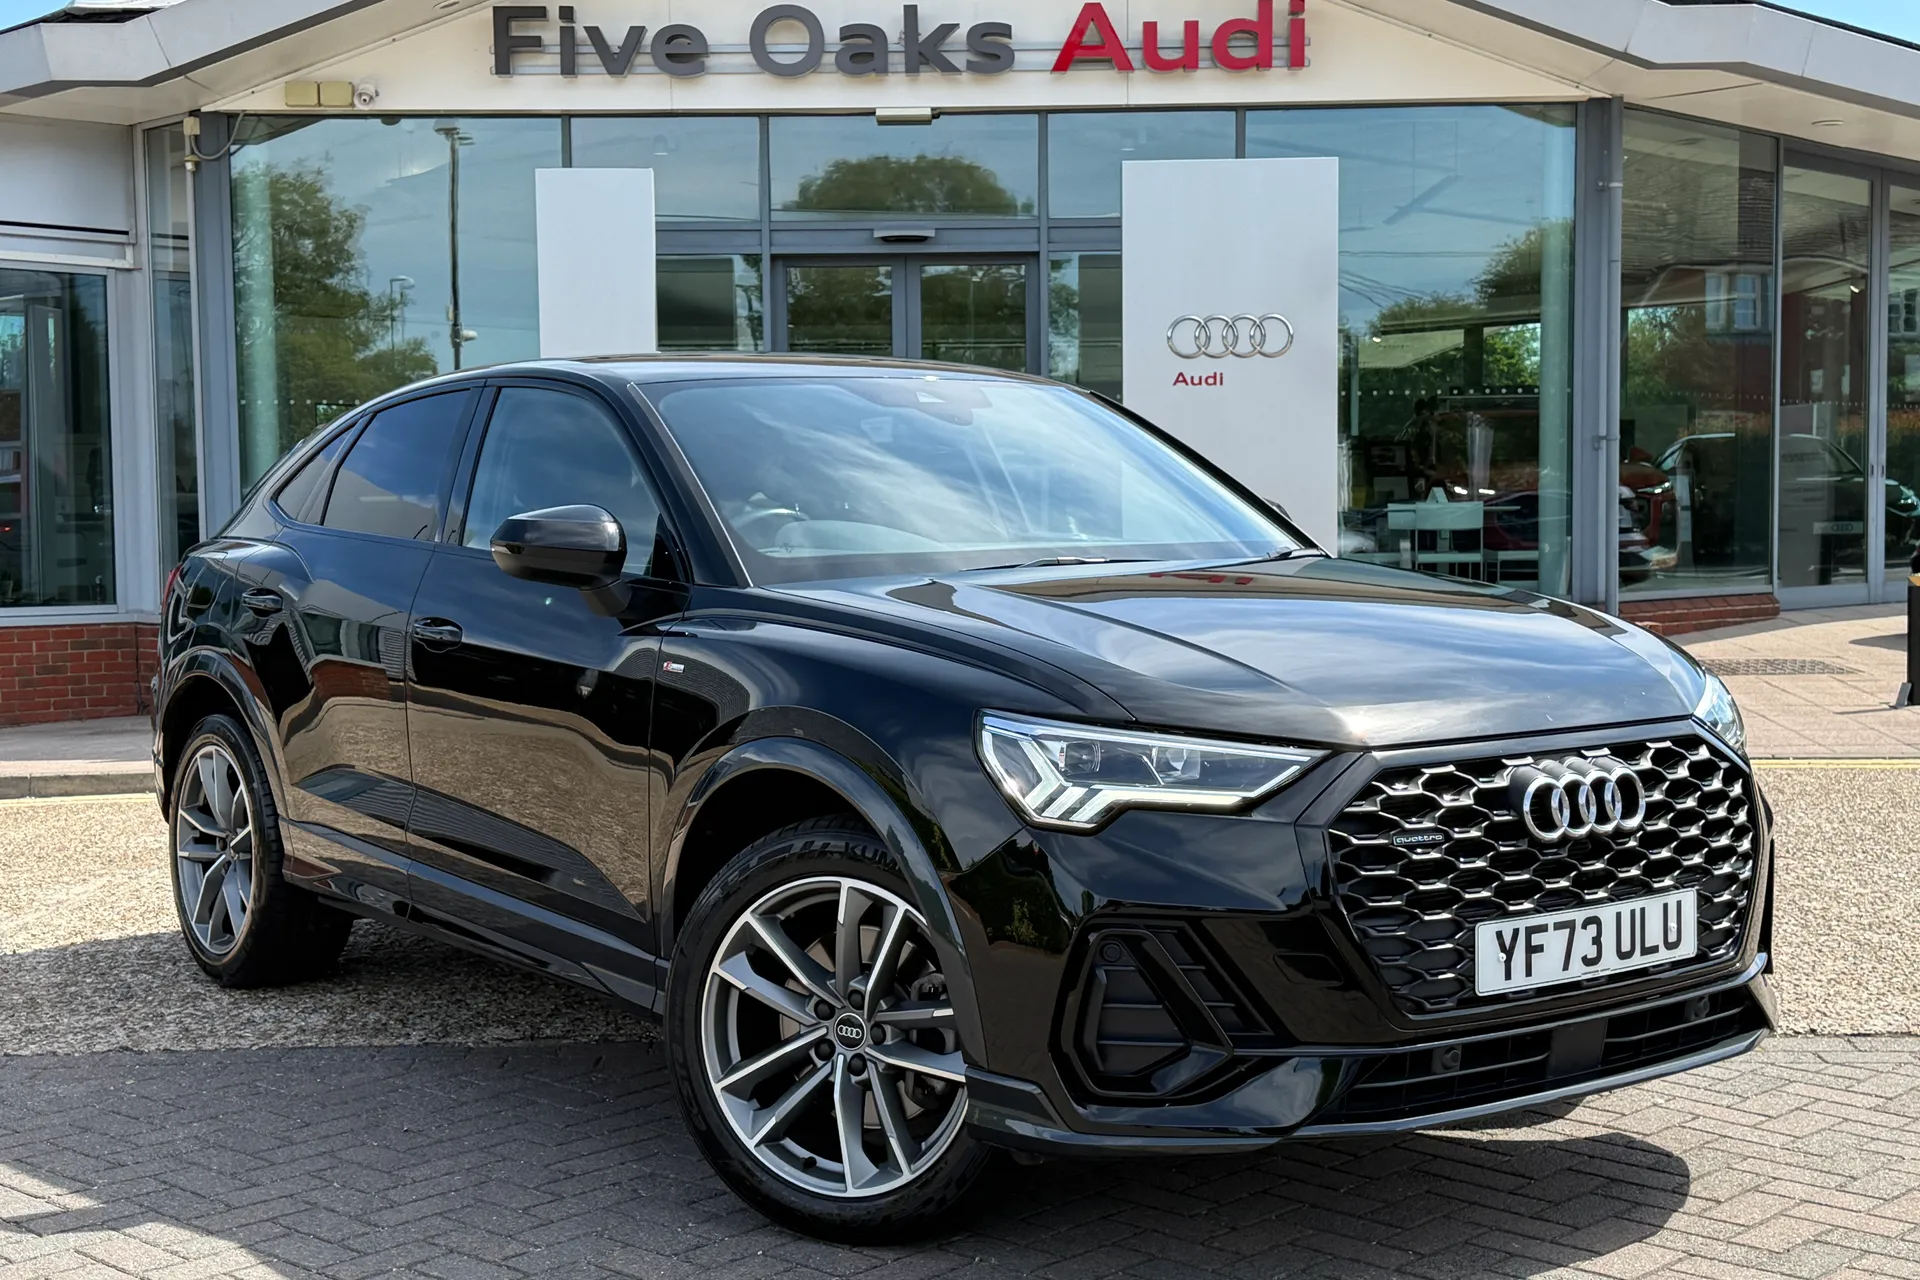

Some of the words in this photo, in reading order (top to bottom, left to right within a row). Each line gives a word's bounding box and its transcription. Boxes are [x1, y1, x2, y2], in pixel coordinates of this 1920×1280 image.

[493, 5, 709, 77] Five
[749, 4, 1016, 77] Oaks
[1051, 0, 1306, 73] Audi
[1172, 371, 1224, 386] Audi
[1396, 834, 1443, 844] quattro
[843, 841, 900, 872] KUM
[1495, 915, 1603, 981] YF73
[1615, 900, 1683, 961] ULU
